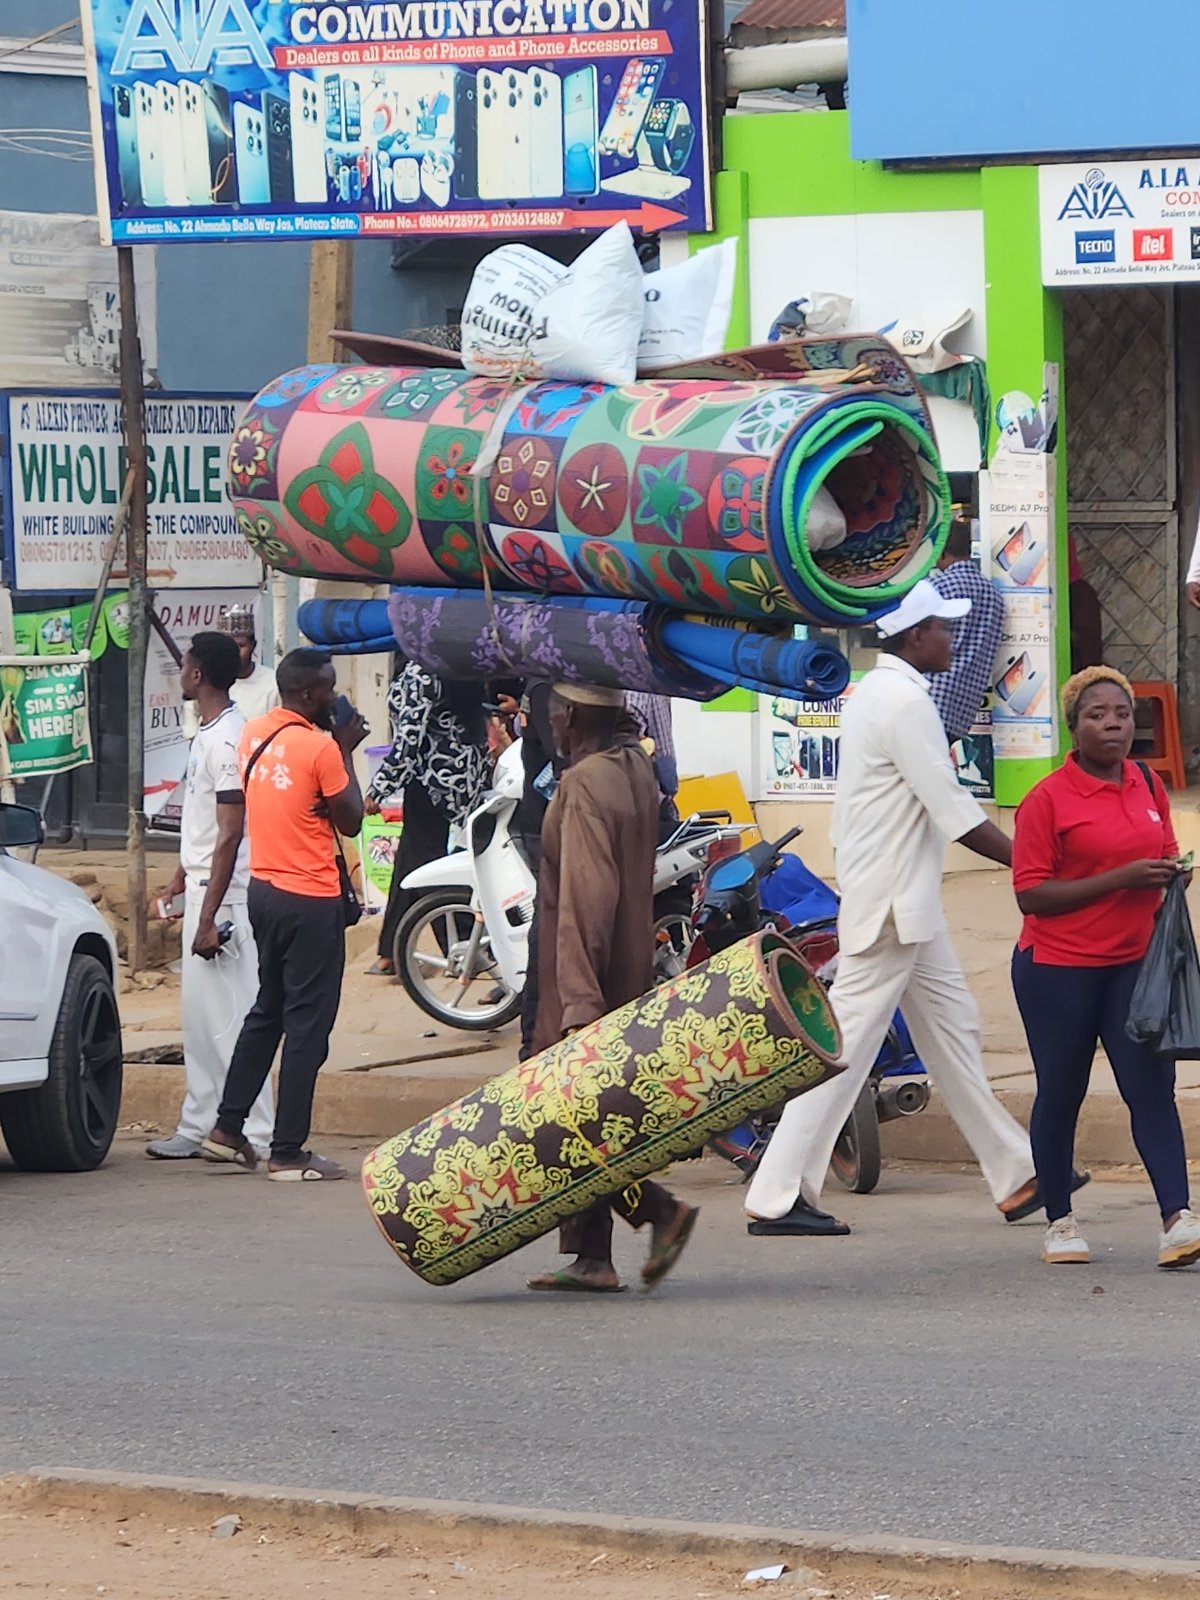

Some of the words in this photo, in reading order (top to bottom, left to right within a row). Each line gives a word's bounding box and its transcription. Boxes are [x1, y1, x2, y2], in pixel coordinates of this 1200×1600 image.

[291, 0, 650, 43] COMMUNICATION
[286, 49, 339, 65] Dealers
[342, 51, 360, 63] on
[362, 46, 379, 61] all
[382, 45, 421, 61] kinds
[424, 44, 437, 59] of
[440, 42, 484, 59] Phone
[488, 41, 516, 57] and
[519, 40, 565, 56] Phone
[568, 35, 658, 53] Accessories
[365, 215, 395, 229] Phone
[491, 211, 564, 227] 07036124867
[1161, 209, 1186, 218] Dealers
[1188, 209, 1196, 217] on
[127, 221, 164, 234] Address:
[165, 220, 180, 233] No.
[181, 219, 193, 233] 22
[232, 218, 254, 232] Bello
[256, 217, 275, 234] Way
[295, 216, 329, 231] Plateau
[330, 215, 357, 230] State.
[1078, 239, 1113, 254] TECNO
[1141, 234, 1166, 256] itel
[1093, 266, 1101, 274] 22
[36, 402, 69, 432] ALEXIS
[175, 405, 195, 433] AND
[197, 405, 236, 434] REPAIRS
[1020, 503, 1031, 512] A7
[1033, 503, 1050, 513] Pro
[23, 515, 59, 536] WHITE
[63, 515, 115, 535] BUILDING
[155, 514, 176, 534] THE
[1019, 633, 1032, 642] A7
[1033, 633, 1049, 643] Pro
[25, 665, 49, 681] SIM
[25, 698, 53, 716] SIM
[56, 690, 85, 711] SWAP
[27, 714, 74, 740] HERE
